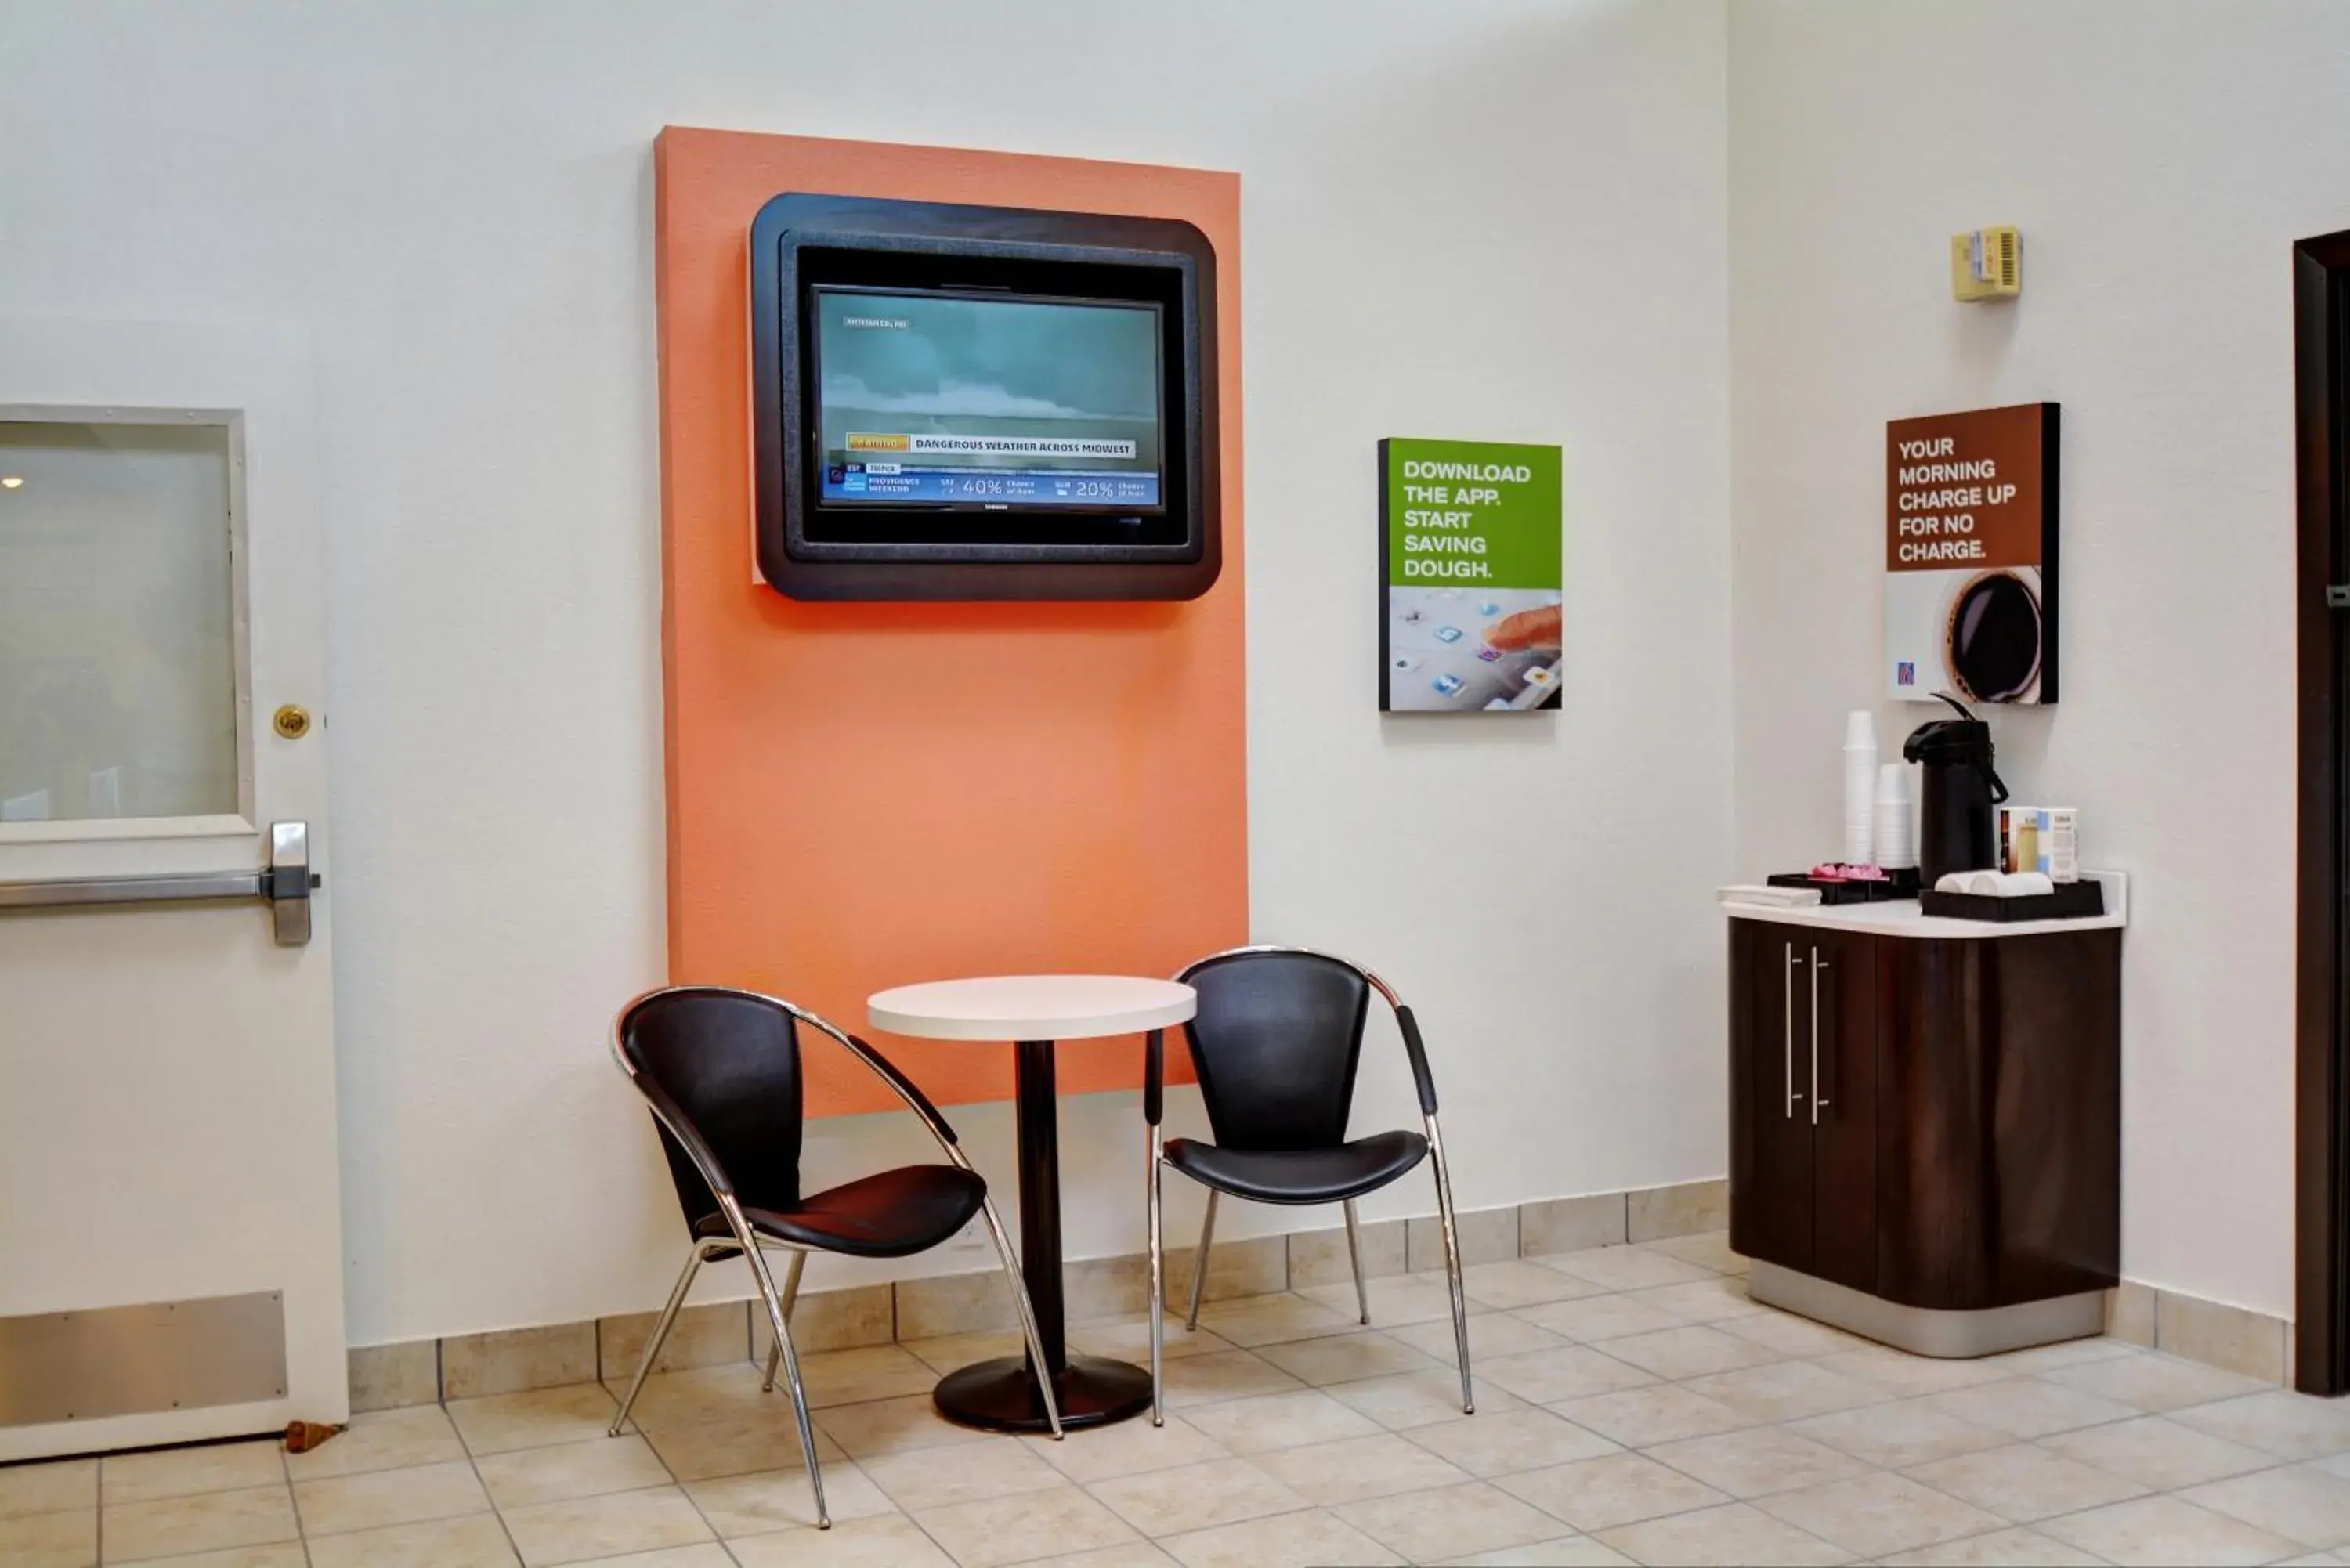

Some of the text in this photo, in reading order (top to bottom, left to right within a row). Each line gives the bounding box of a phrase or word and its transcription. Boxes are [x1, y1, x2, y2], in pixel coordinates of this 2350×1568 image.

[916, 439, 983, 450] DANGEROUS
[986, 441, 1036, 451] WEATHER
[1039, 443, 1079, 452] ACROSS
[1082, 443, 1130, 454] MIDWEST
[1899, 437, 1955, 460] YOUR
[1404, 461, 1531, 482] DOWNLOAD
[1899, 458, 1996, 486] MORNING
[963, 479, 1002, 494] 40%
[1077, 481, 1113, 497] 20%
[1404, 485, 1501, 506] THE APP.
[1899, 483, 2016, 511] CHARGE UP
[1404, 509, 1472, 529] START
[1900, 513, 1974, 537] FOR NO
[1405, 534, 1486, 554] SAVING
[1899, 539, 1986, 562] CHARGE.
[1405, 559, 1492, 578] DOUGH.
